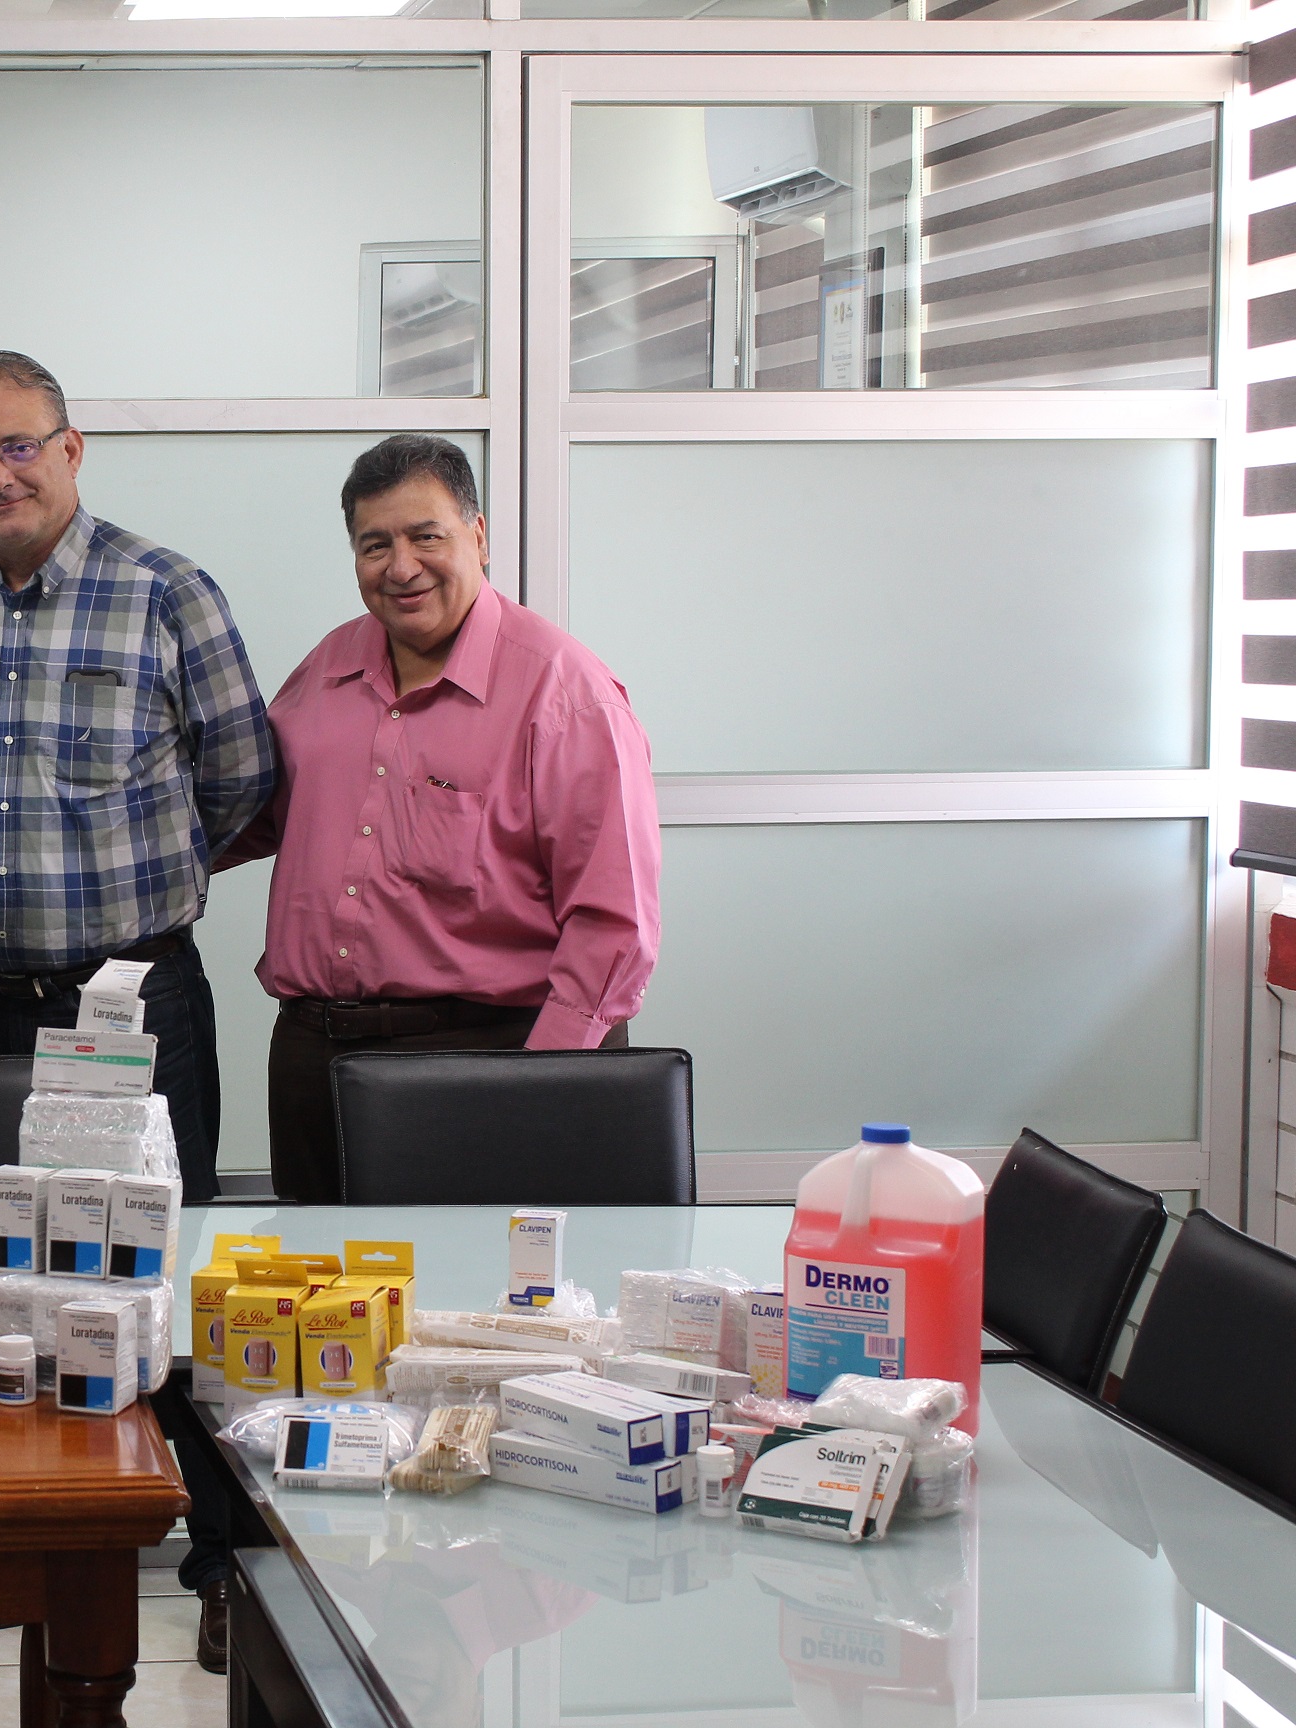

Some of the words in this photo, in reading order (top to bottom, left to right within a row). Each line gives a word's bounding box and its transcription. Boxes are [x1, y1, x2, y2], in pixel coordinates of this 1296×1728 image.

[93, 1007, 133, 1023] Loratadina
[44, 1032, 96, 1044] Paracetamol
[61, 1193, 104, 1207] Loratadina
[125, 1197, 167, 1213] Loratadina
[519, 1224, 552, 1234] CLAVIPEN
[805, 1264, 889, 1295] DERMO
[672, 1290, 721, 1308] CLAVIPEN
[825, 1290, 890, 1311] CLEEN
[230, 1309, 249, 1325] Le
[248, 1309, 274, 1327] Roy
[751, 1303, 784, 1319] CLAVIP
[305, 1313, 324, 1330] Le
[322, 1314, 349, 1329] Roy
[71, 1326, 115, 1340] Loratadina
[505, 1396, 569, 1425] HIDROCORTISONA
[334, 1440, 383, 1450] Sulfametoxazol
[335, 1432, 378, 1442] Trimetoprima
[495, 1449, 579, 1475] HIDROCORTISONA
[816, 1447, 866, 1466] Soltrim
